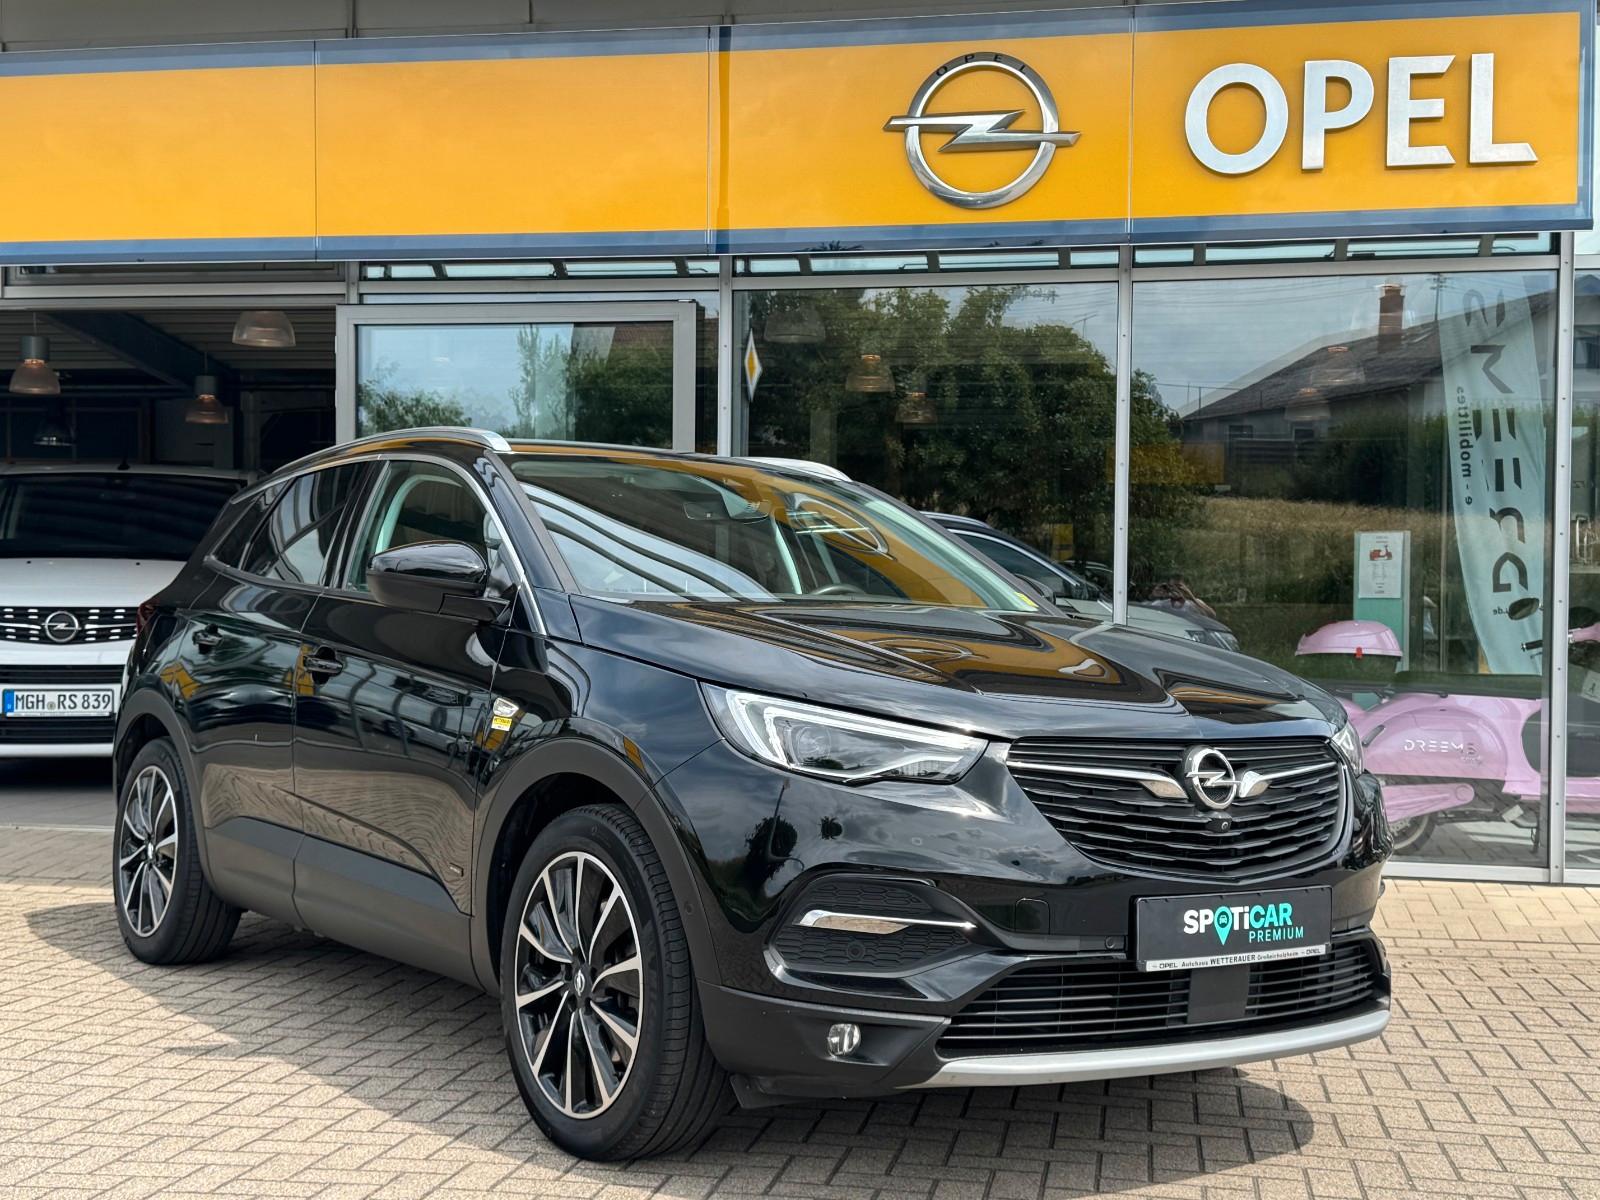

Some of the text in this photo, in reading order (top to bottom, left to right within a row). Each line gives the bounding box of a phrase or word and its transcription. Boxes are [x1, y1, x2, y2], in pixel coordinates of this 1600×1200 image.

[936, 54, 1026, 76] OPEL
[1185, 53, 1539, 175] OPEL
[15, 694, 111, 710] MGH RS 839
[1249, 926, 1304, 943] PREMIUM
[1210, 955, 1256, 965] WETTERAUER
